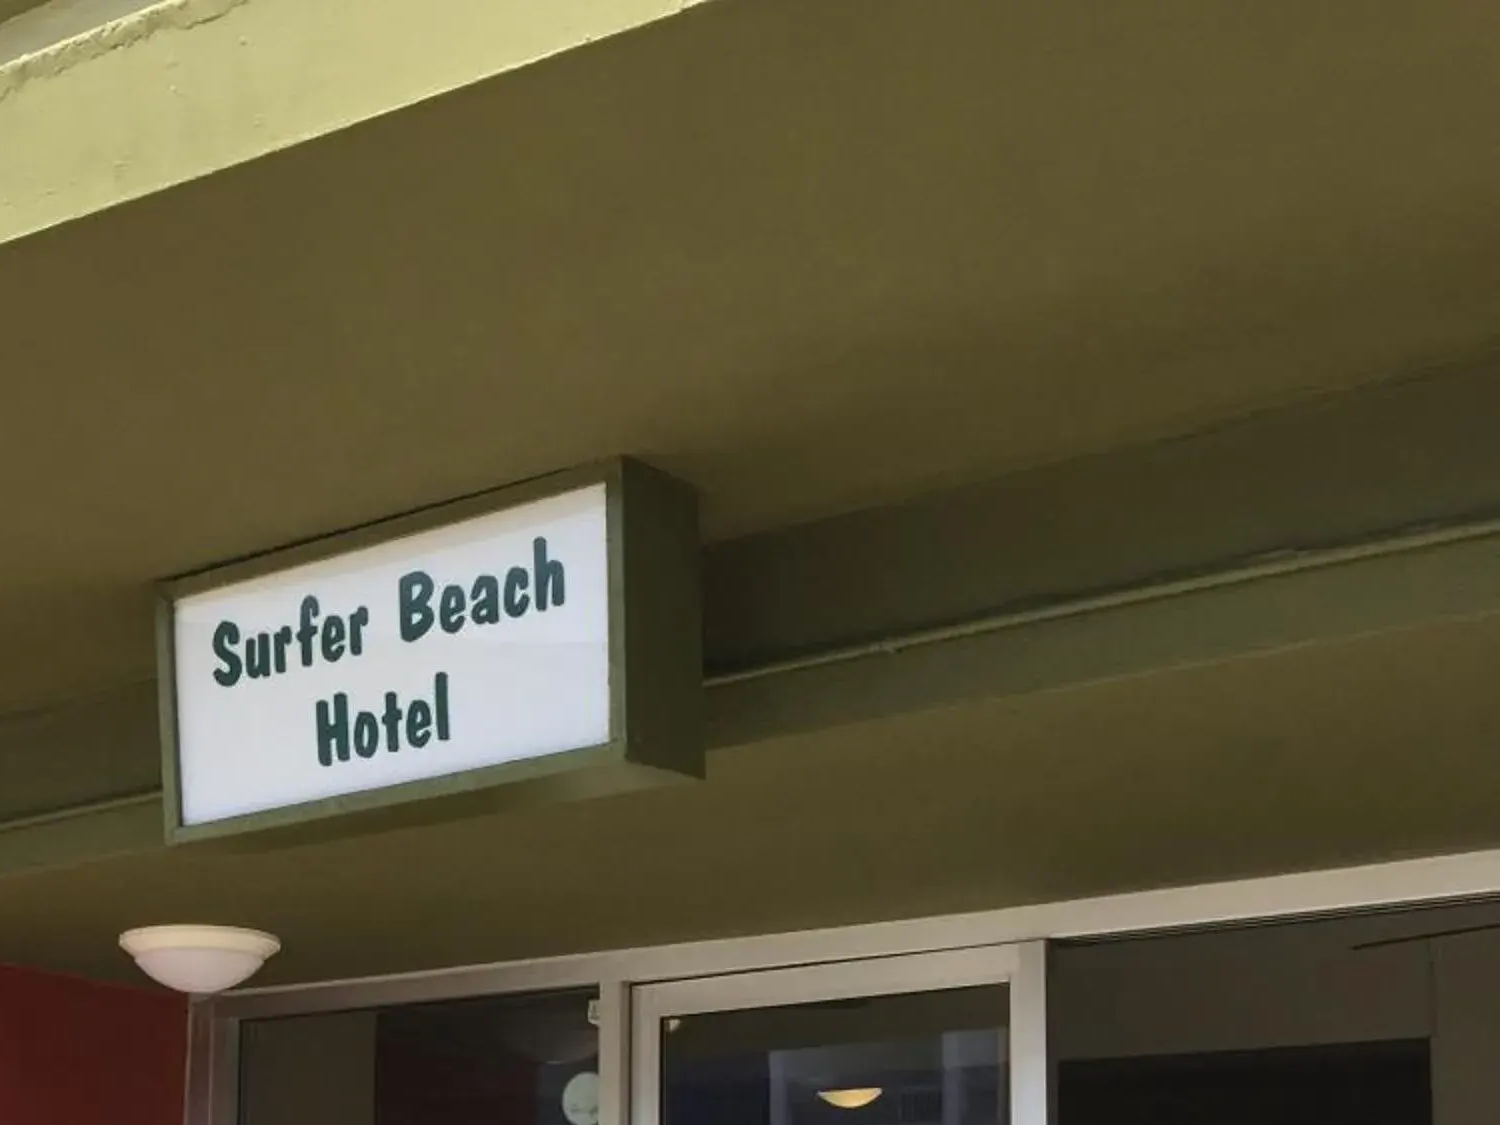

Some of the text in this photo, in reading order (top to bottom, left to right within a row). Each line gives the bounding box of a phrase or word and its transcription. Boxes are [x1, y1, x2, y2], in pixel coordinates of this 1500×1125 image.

[212, 536, 565, 688] Surfer Beach
[315, 671, 450, 767] Hotel
